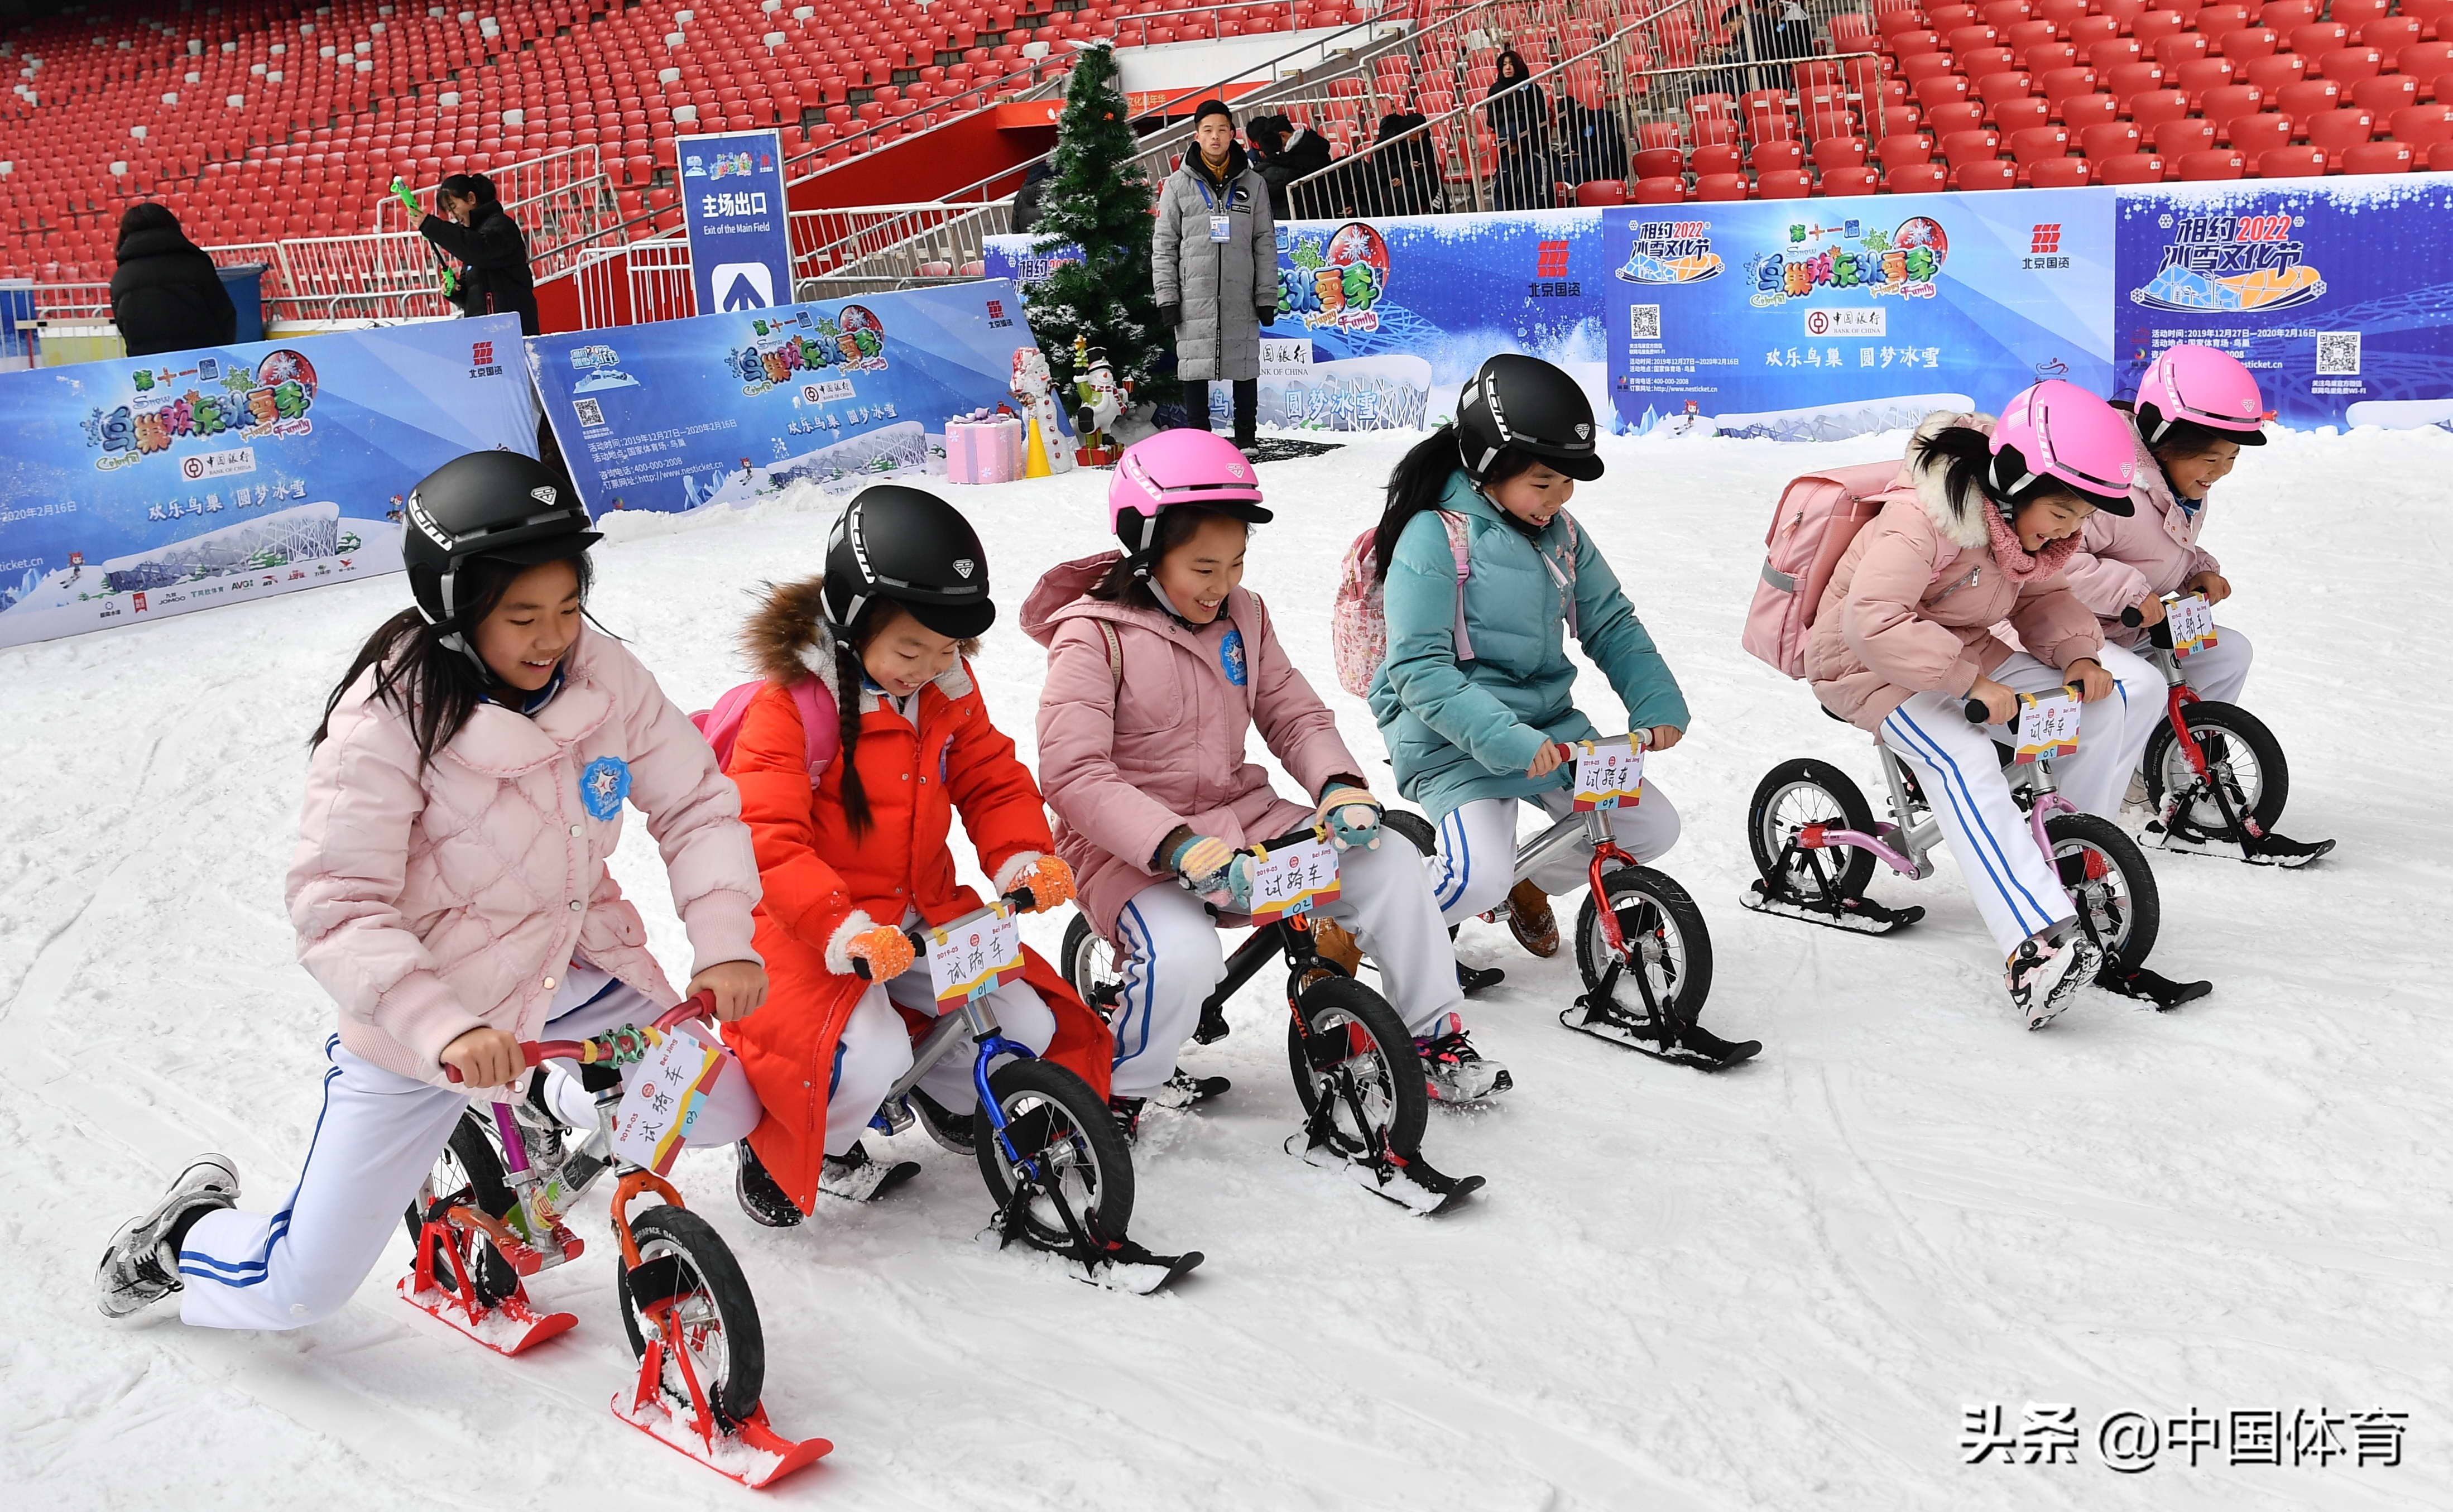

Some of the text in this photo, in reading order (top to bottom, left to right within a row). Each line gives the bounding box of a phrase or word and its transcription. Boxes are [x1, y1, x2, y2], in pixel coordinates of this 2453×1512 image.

[702, 191, 767, 218] 主场出口
[704, 221, 770, 235] Exit of the Main Field
[1640, 222, 1704, 239] 相约2022
[1789, 219, 1860, 242] 第十一届
[2175, 215, 2292, 243] 相约2022
[1631, 239, 1710, 262] 冰雪文化节
[1787, 246, 1817, 257] Snow
[2159, 242, 2303, 280] 冰雪文化节
[1758, 246, 1938, 297] 鸟巢欢乐冰雪季
[2022, 257, 2070, 270] 北京国资
[1528, 282, 1581, 297] 北京国资
[1871, 283, 1936, 300] Happy Family
[752, 311, 813, 337] 第十一届
[1305, 310, 1377, 333] Happy Family
[740, 329, 882, 383] 鸟巢欢乐冰雪季
[1765, 346, 1941, 368] 欢乐鸟巢 圆梦冰雪
[133, 358, 218, 391] 第十一届
[468, 366, 503, 379] 北京国资
[1211, 388, 1378, 420] 鸟 圆梦冰雪
[102, 381, 310, 455] 鸟巢欢乐冰雪季
[273, 419, 312, 439] Family
[788, 402, 898, 435] 欢乐鸟巢 圆梦冰雪
[148, 479, 306, 521] 欢乐鸟巢 圆梦冰雪
[159, 596, 186, 605] JOMOO
[2043, 748, 2054, 757] 05
[1256, 866, 1278, 876] 2019-05
[1292, 900, 1311, 914] 02
[1001, 922, 1011, 931] Jing
[937, 946, 959, 960] 2019-05
[978, 982, 986, 995] 01
[660, 1039, 678, 1066] Bei Jing
[620, 1113, 639, 1142] 2019-05
[687, 1110, 698, 1124] 03
